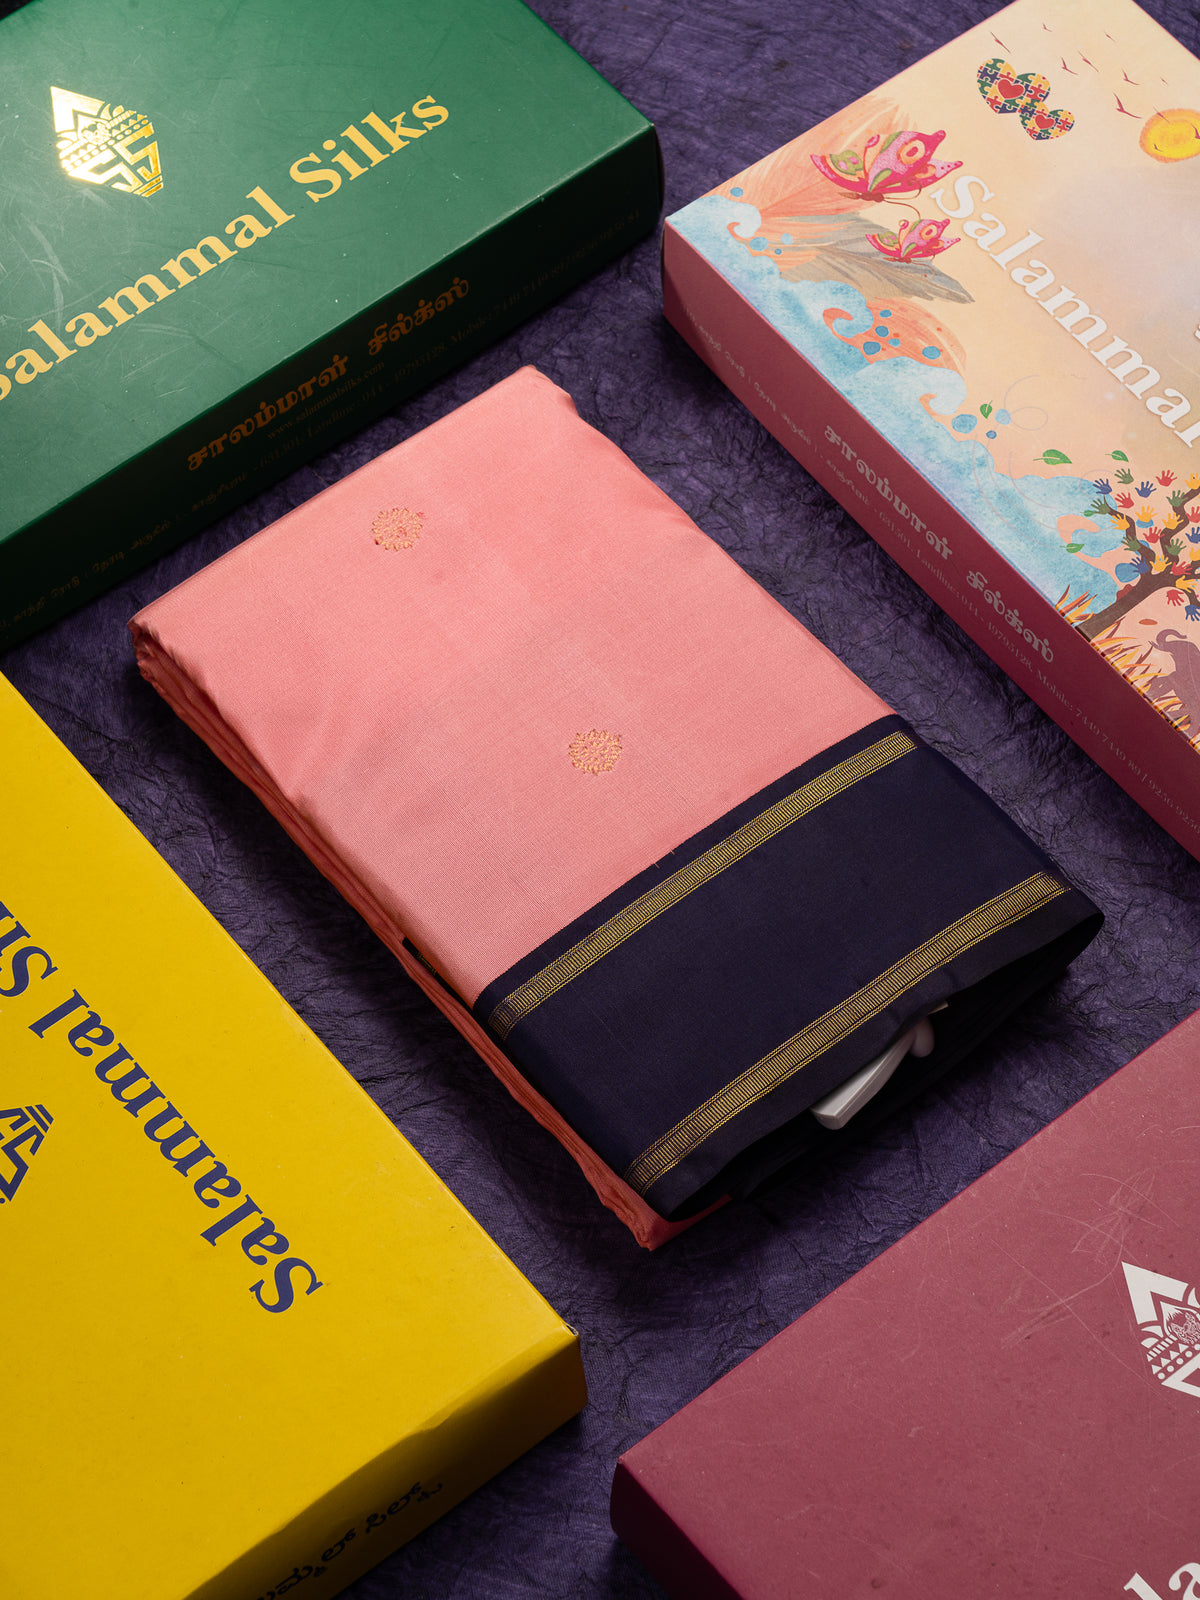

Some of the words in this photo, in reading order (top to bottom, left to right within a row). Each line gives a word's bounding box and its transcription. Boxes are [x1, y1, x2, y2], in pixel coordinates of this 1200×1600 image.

[0, 186, 296, 402] alammal
[289, 95, 449, 203] Silks
[187, 354, 348, 471] சாலம்மாள்
[368, 277, 469, 355] சில்க்ஸ்
[824, 425, 953, 560] சாலம்மாள்
[966, 570, 1054, 663] சில்க்ஸ்
[27, 988, 324, 1314] Salammal
